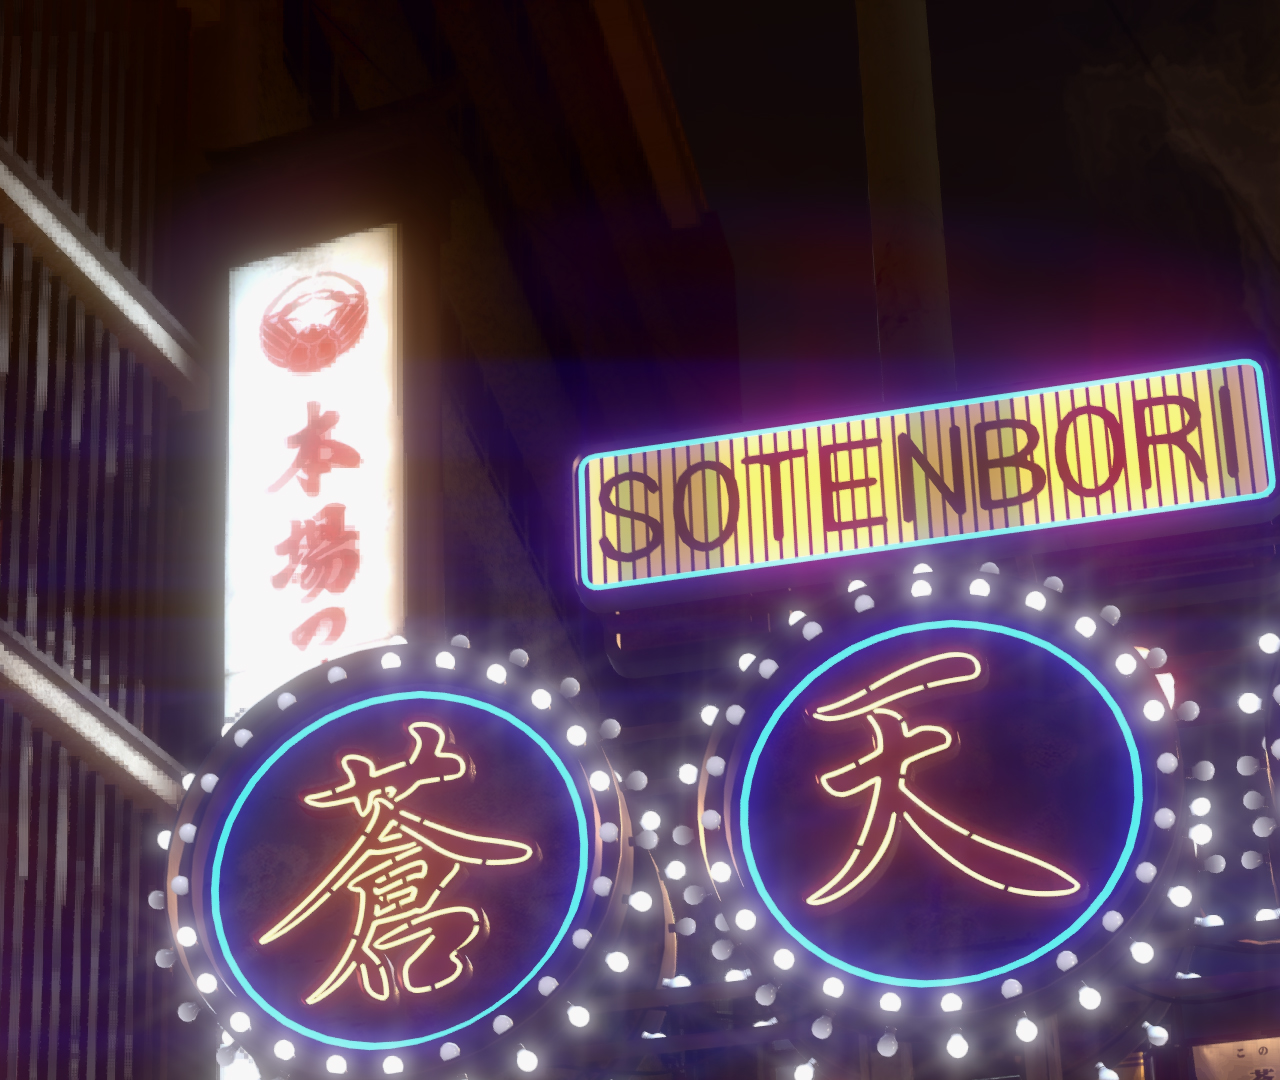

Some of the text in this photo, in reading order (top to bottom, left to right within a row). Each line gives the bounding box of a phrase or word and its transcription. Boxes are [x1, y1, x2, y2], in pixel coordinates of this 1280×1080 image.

[266, 400, 363, 652] 本場の
[598, 384, 1240, 563] SOTENBORI
